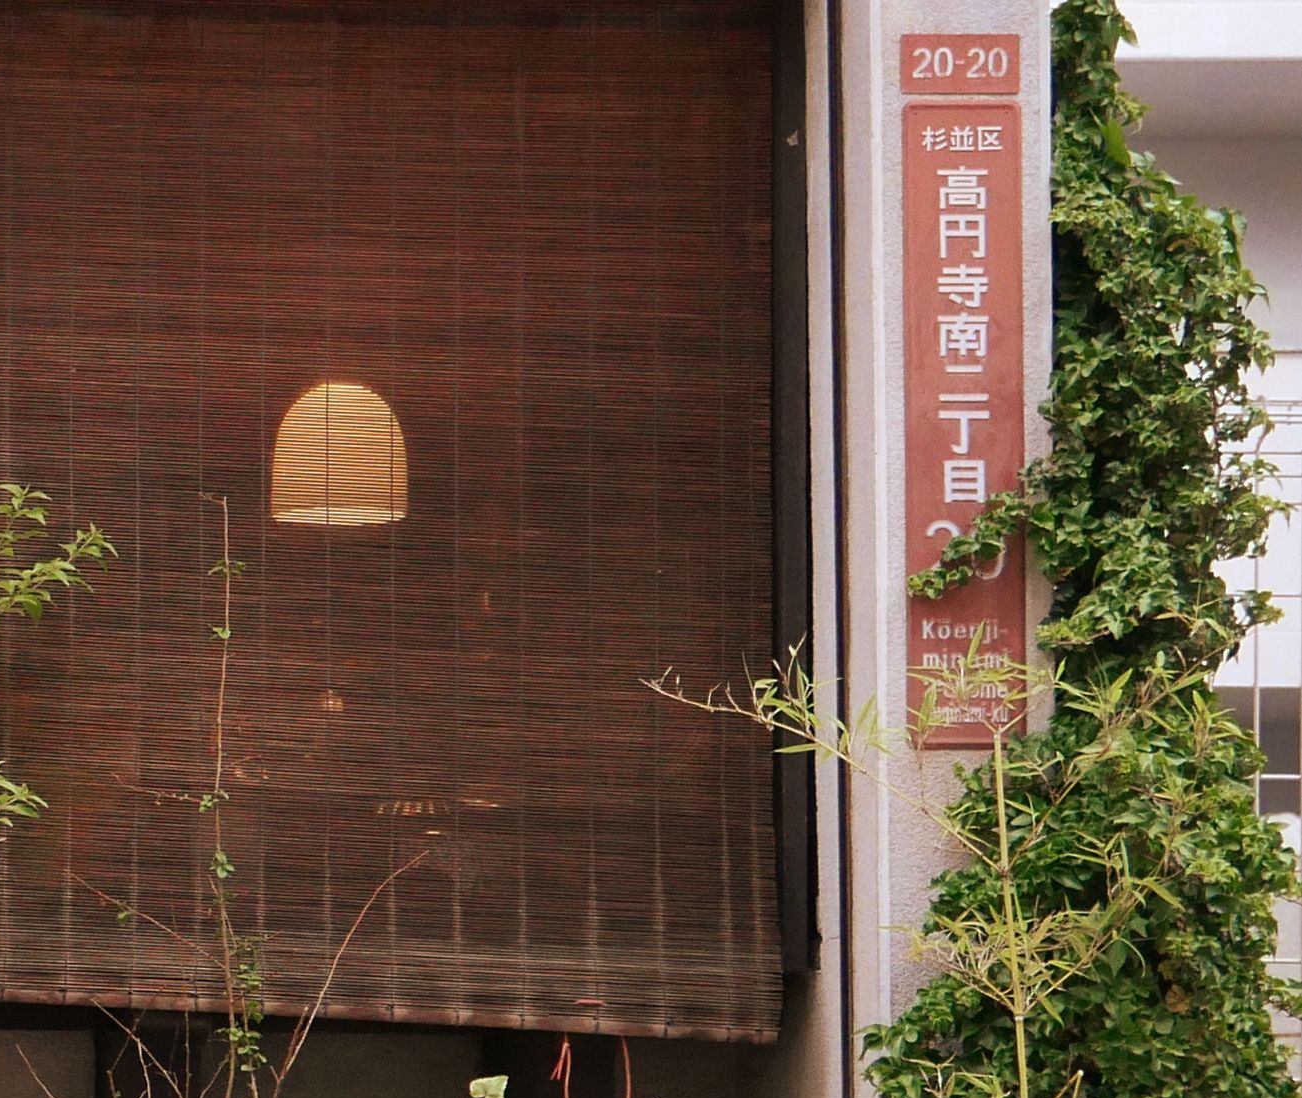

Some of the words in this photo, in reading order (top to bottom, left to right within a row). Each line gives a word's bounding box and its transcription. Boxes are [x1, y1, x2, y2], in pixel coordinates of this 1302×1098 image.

[911, 47, 1009, 79] 20-20
[922, 126, 1003, 151] 杉並区
[936, 165, 990, 503] 高円寺南二丁目
